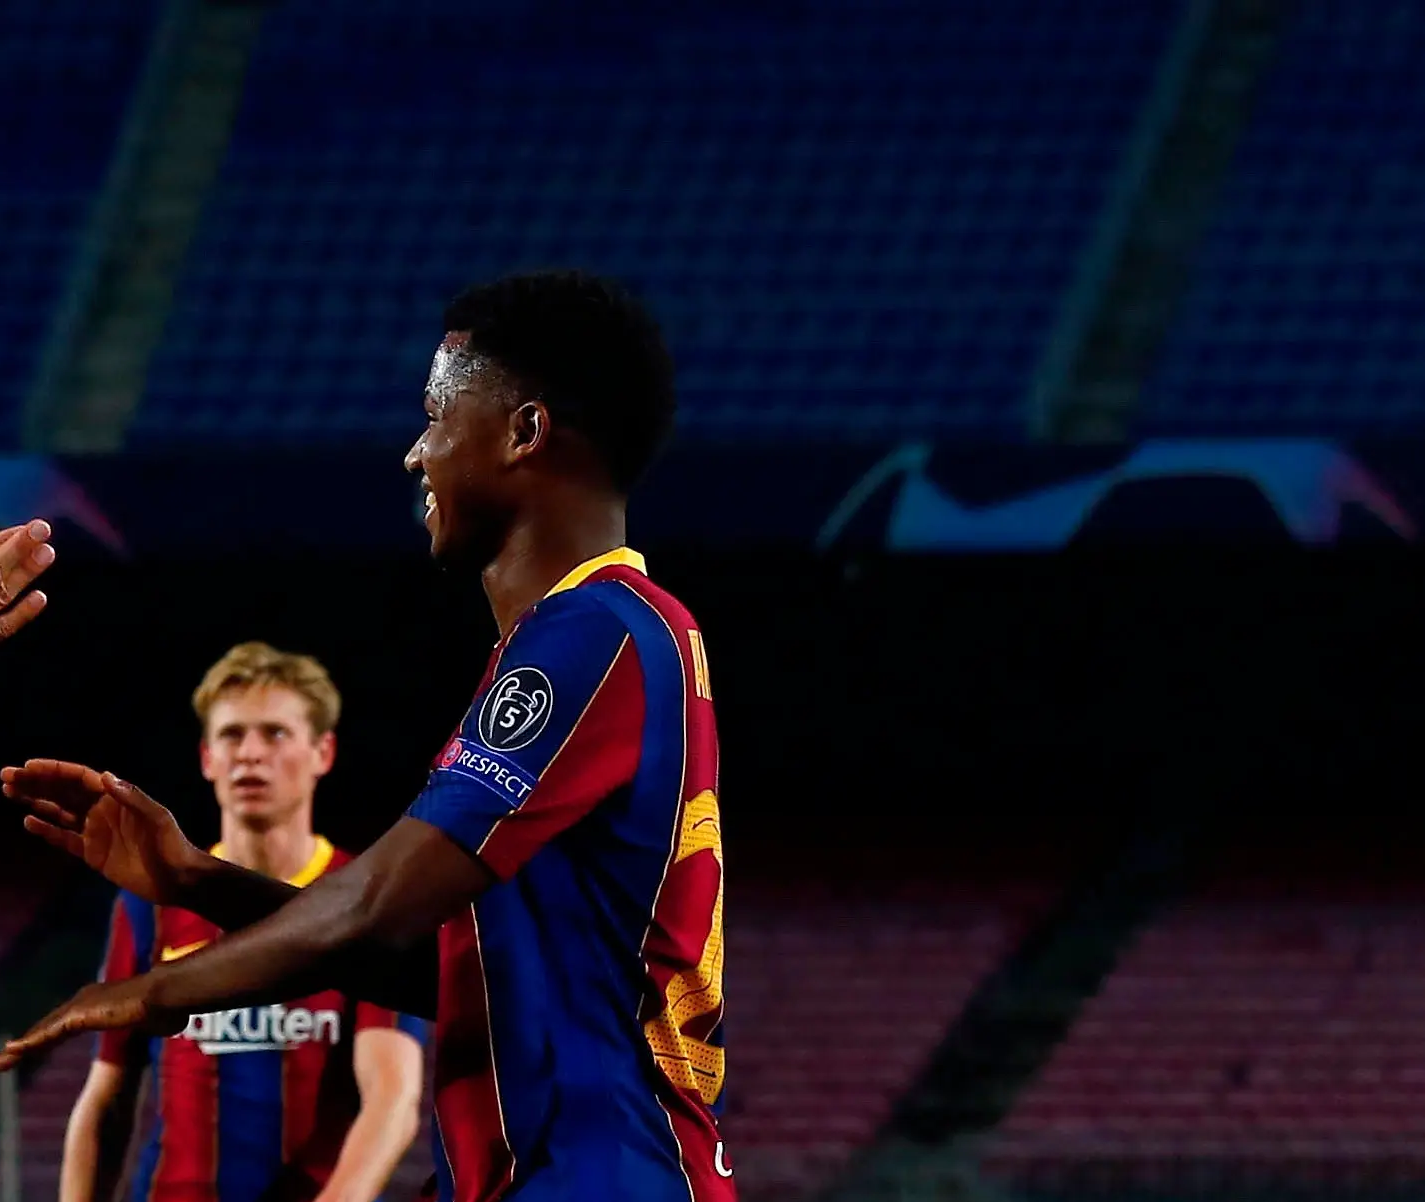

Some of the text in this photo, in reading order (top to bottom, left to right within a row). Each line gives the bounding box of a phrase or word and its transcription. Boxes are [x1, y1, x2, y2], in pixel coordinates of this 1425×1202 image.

[499, 706, 521, 728] 5
[456, 750, 532, 798] RESPECT
[181, 1003, 342, 1046] akuten
